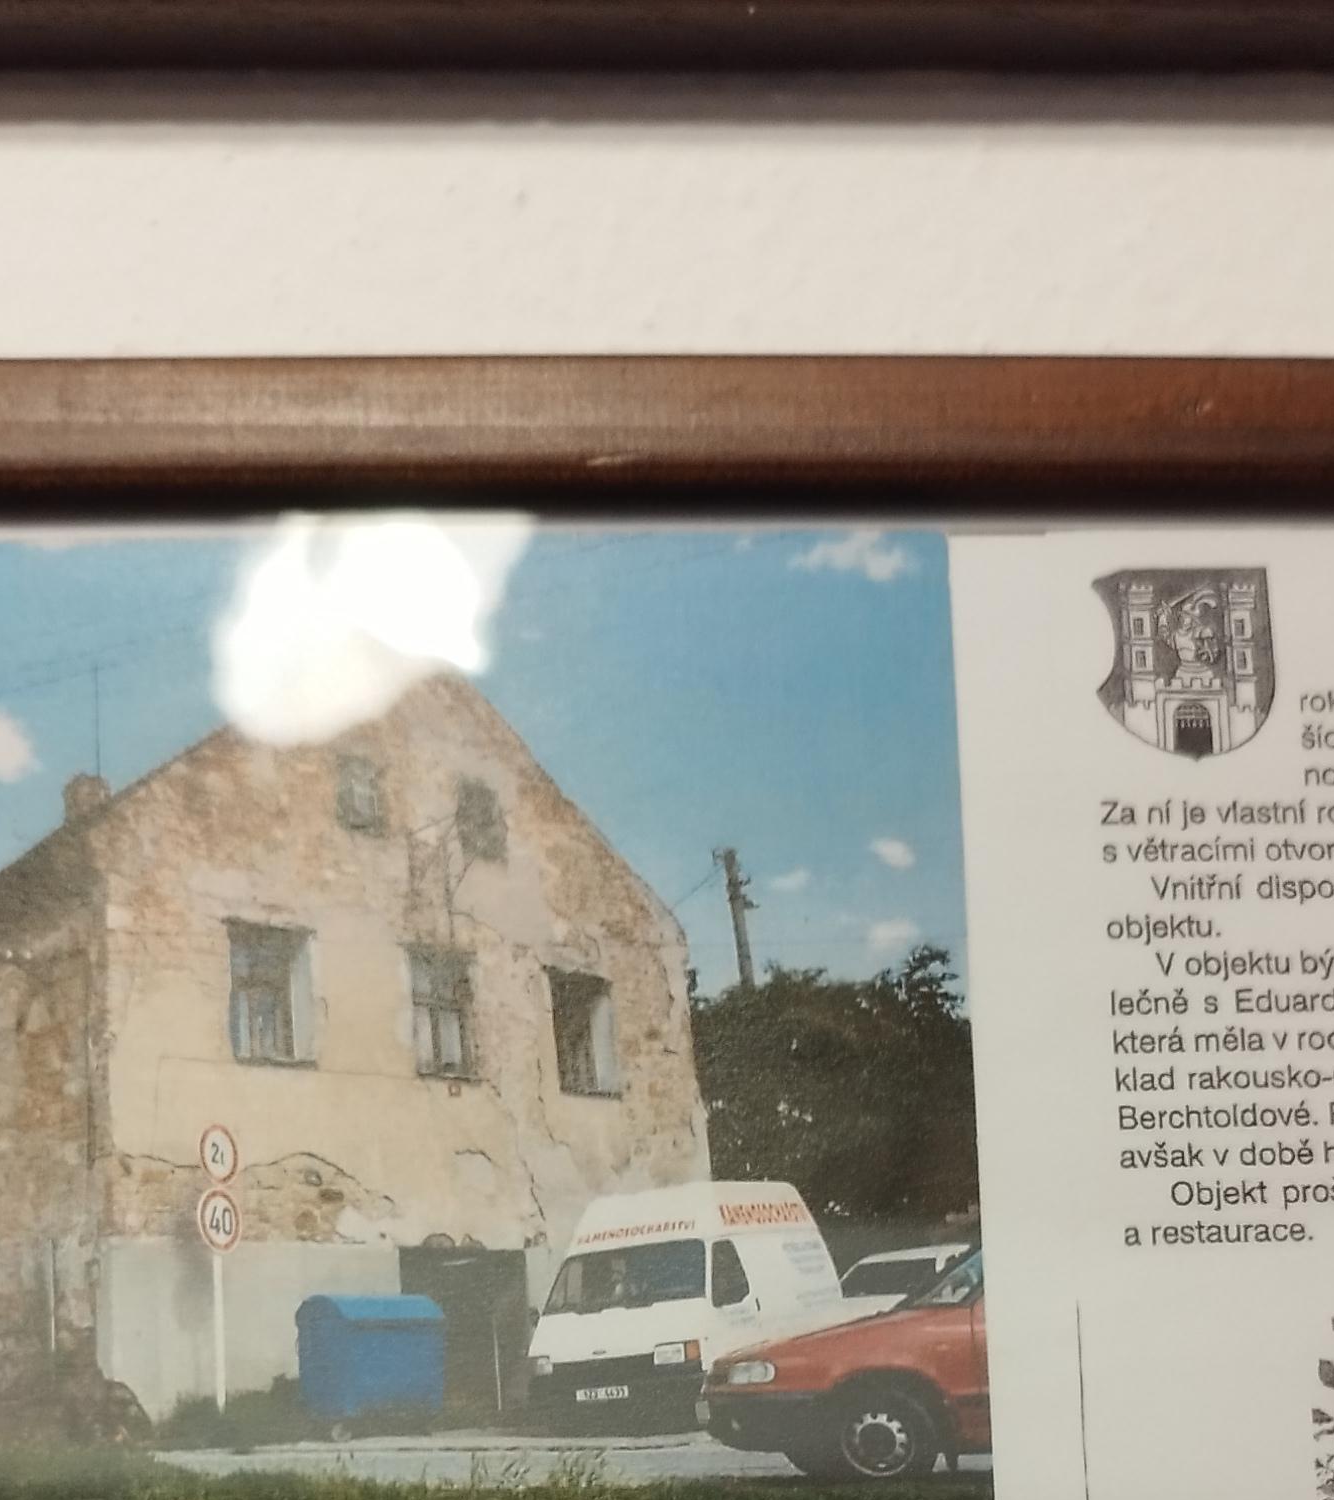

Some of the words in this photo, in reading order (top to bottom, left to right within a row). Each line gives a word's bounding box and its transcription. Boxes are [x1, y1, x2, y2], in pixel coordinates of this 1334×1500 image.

[1100, 799, 1137, 826] Za
[1147, 798, 1172, 825] ní
[1182, 799, 1207, 831] je
[1216, 798, 1307, 826] vlastní
[1102, 843, 1118, 864] s
[1126, 834, 1256, 863] větracími
[1150, 872, 1243, 902] Vnitřní
[1106, 912, 1222, 947] objektu.
[1155, 950, 1176, 978] V
[1184, 948, 1293, 982] objektu
[1110, 986, 1192, 1017] lečně
[1204, 993, 1219, 1014] s
[1113, 1023, 1188, 1056] která
[1194, 1025, 1266, 1055] měla
[1272, 1030, 1289, 1051] v
[1115, 1063, 1179, 1093] klad
[1118, 1099, 1320, 1138] Berchtoldové.
[1120, 1139, 1207, 1170] avšak
[1209, 1144, 1235, 1167] v
[1239, 1137, 1318, 1169] době
[1170, 1178, 1268, 1212] Objekt
[209, 1206, 233, 1236] 40
[1124, 1225, 1142, 1247] a
[1151, 1214, 1314, 1246] restaurace.
